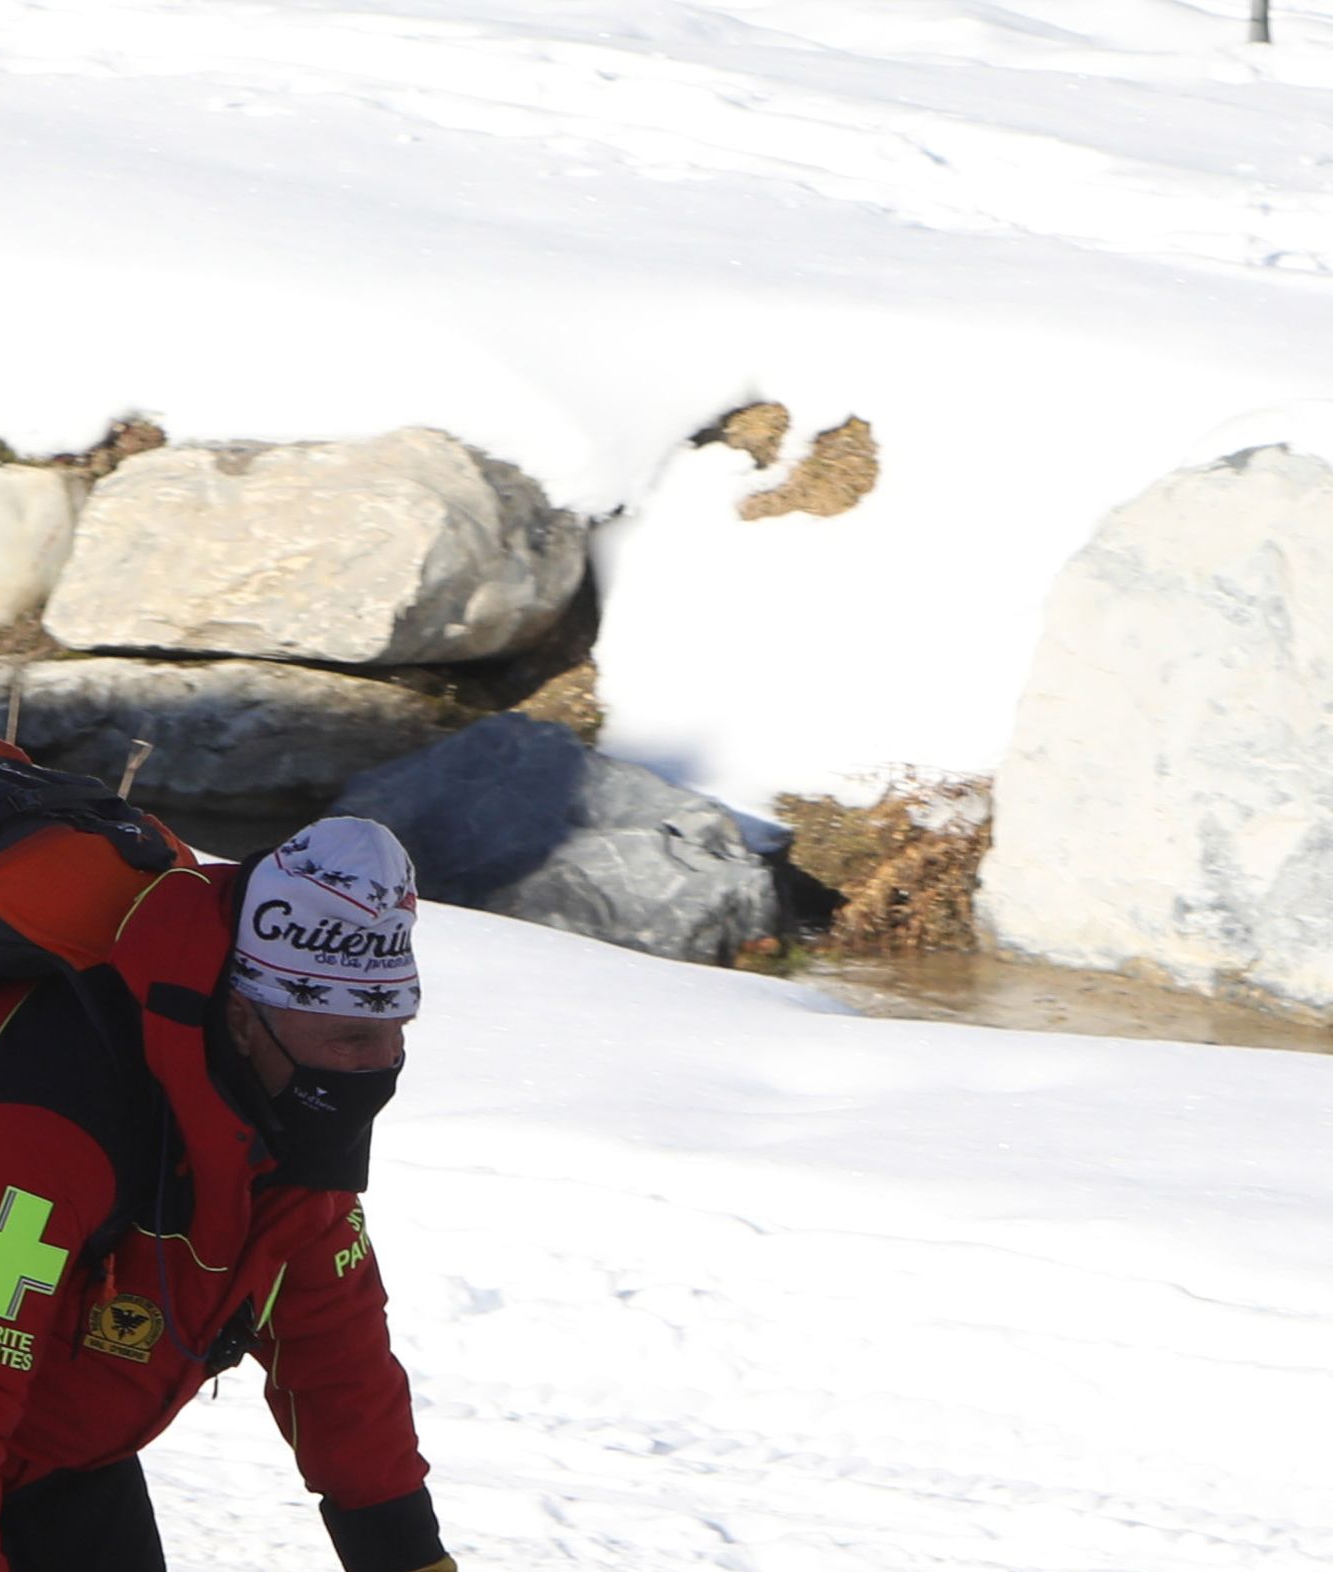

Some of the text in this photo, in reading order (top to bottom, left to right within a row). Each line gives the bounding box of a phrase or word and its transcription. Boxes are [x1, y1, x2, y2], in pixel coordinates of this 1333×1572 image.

[253, 899, 412, 958] Critériu
[314, 951, 414, 973] de la prem
